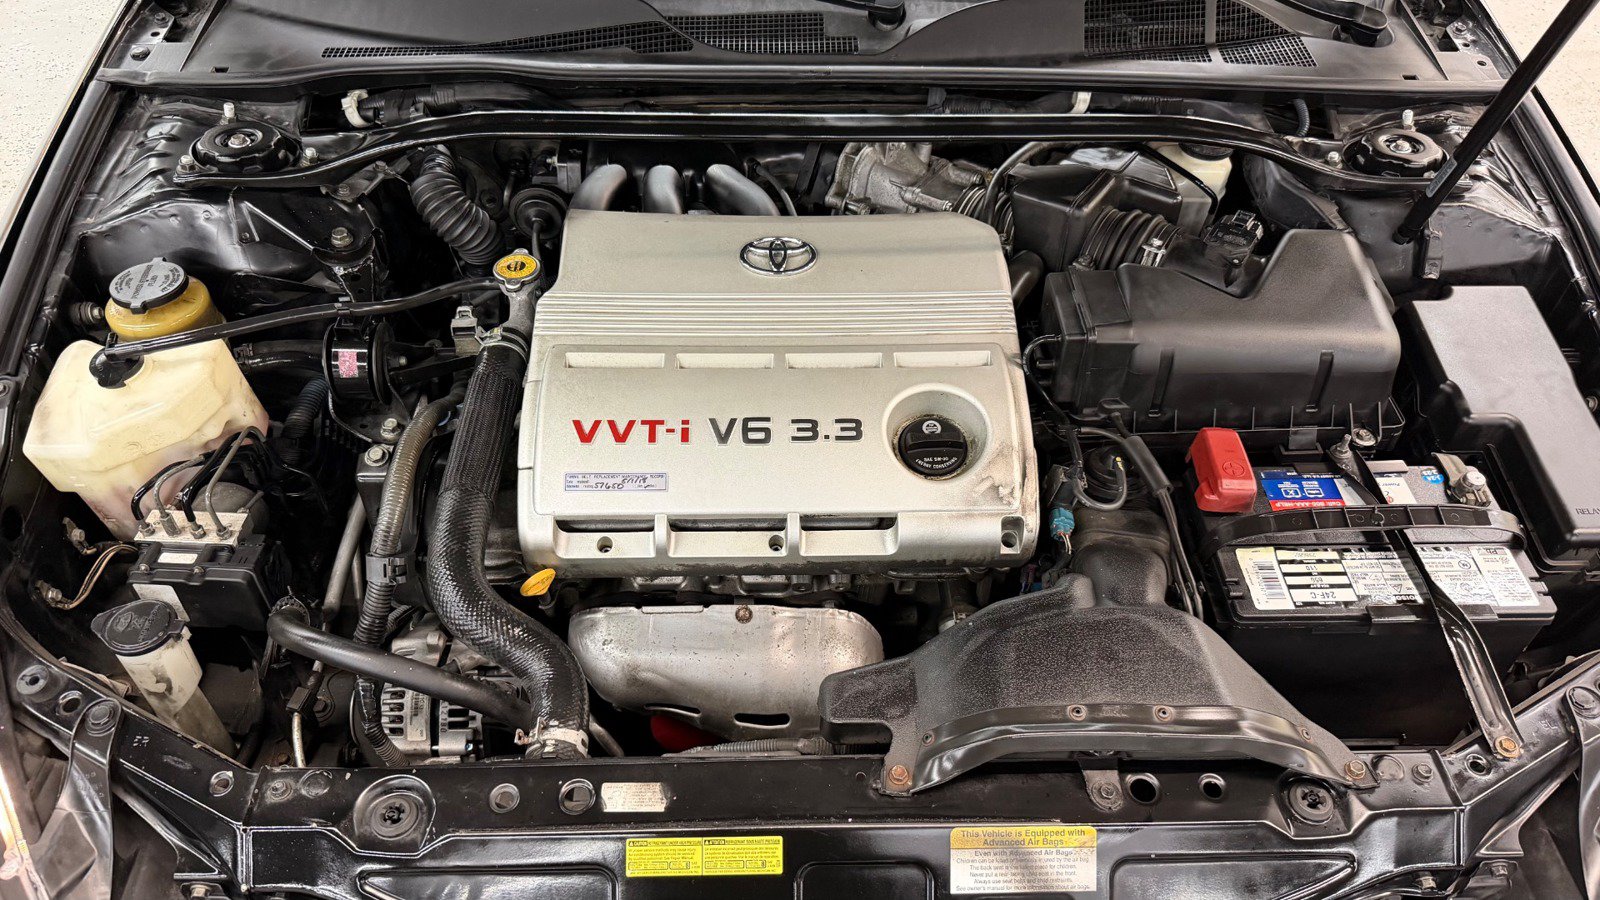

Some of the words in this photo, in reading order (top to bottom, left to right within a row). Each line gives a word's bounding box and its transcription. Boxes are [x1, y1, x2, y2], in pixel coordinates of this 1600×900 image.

[572, 419, 690, 444] VVT-i
[708, 416, 772, 445] V6
[790, 418, 864, 442] 3.3
[982, 829, 1012, 838] Vehicle
[1025, 829, 1065, 839] Equipped
